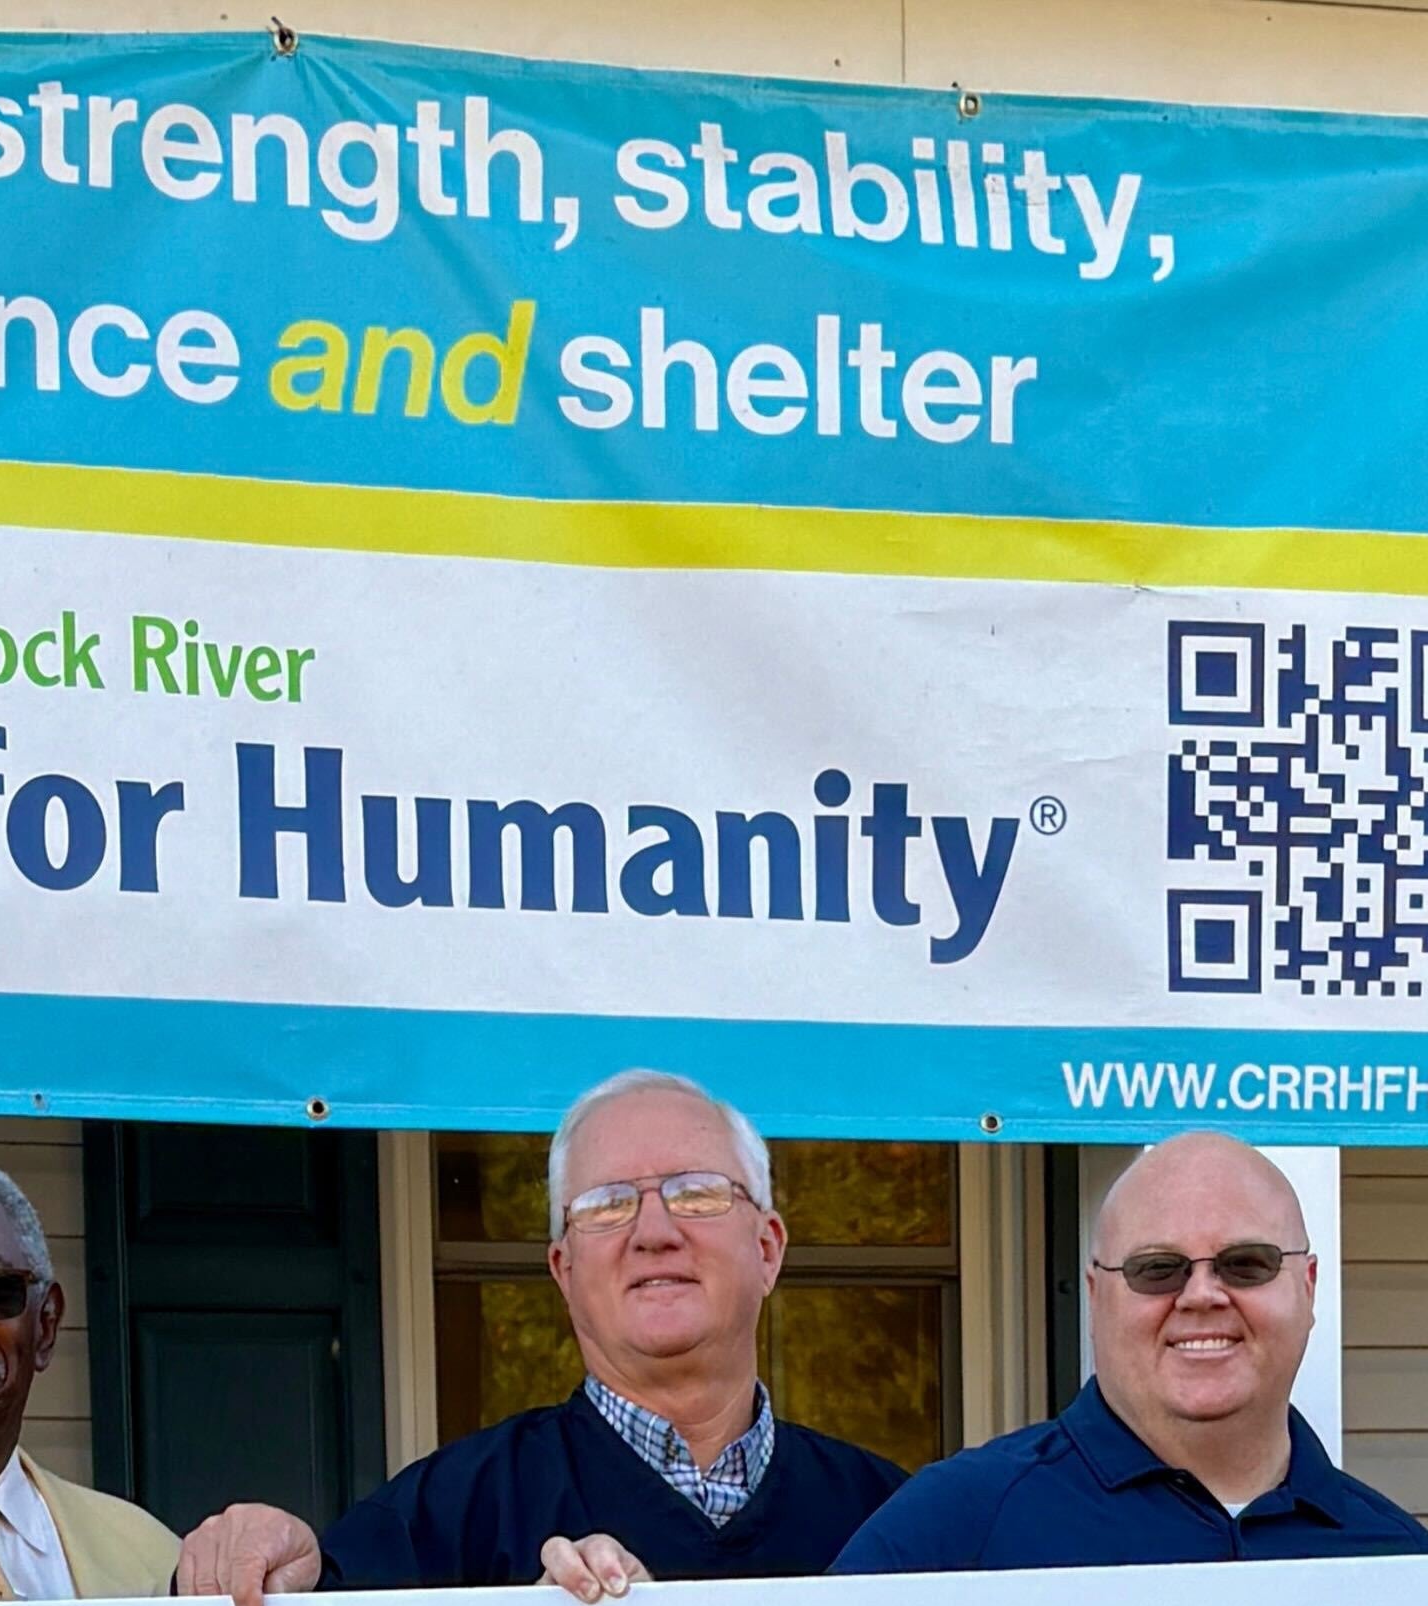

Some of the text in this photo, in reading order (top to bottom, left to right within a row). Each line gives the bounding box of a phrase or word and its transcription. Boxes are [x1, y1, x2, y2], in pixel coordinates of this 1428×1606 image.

[614, 123, 1174, 281] stability,
[271, 302, 533, 424] and
[559, 308, 1036, 443] shelter
[132, 616, 314, 702] River
